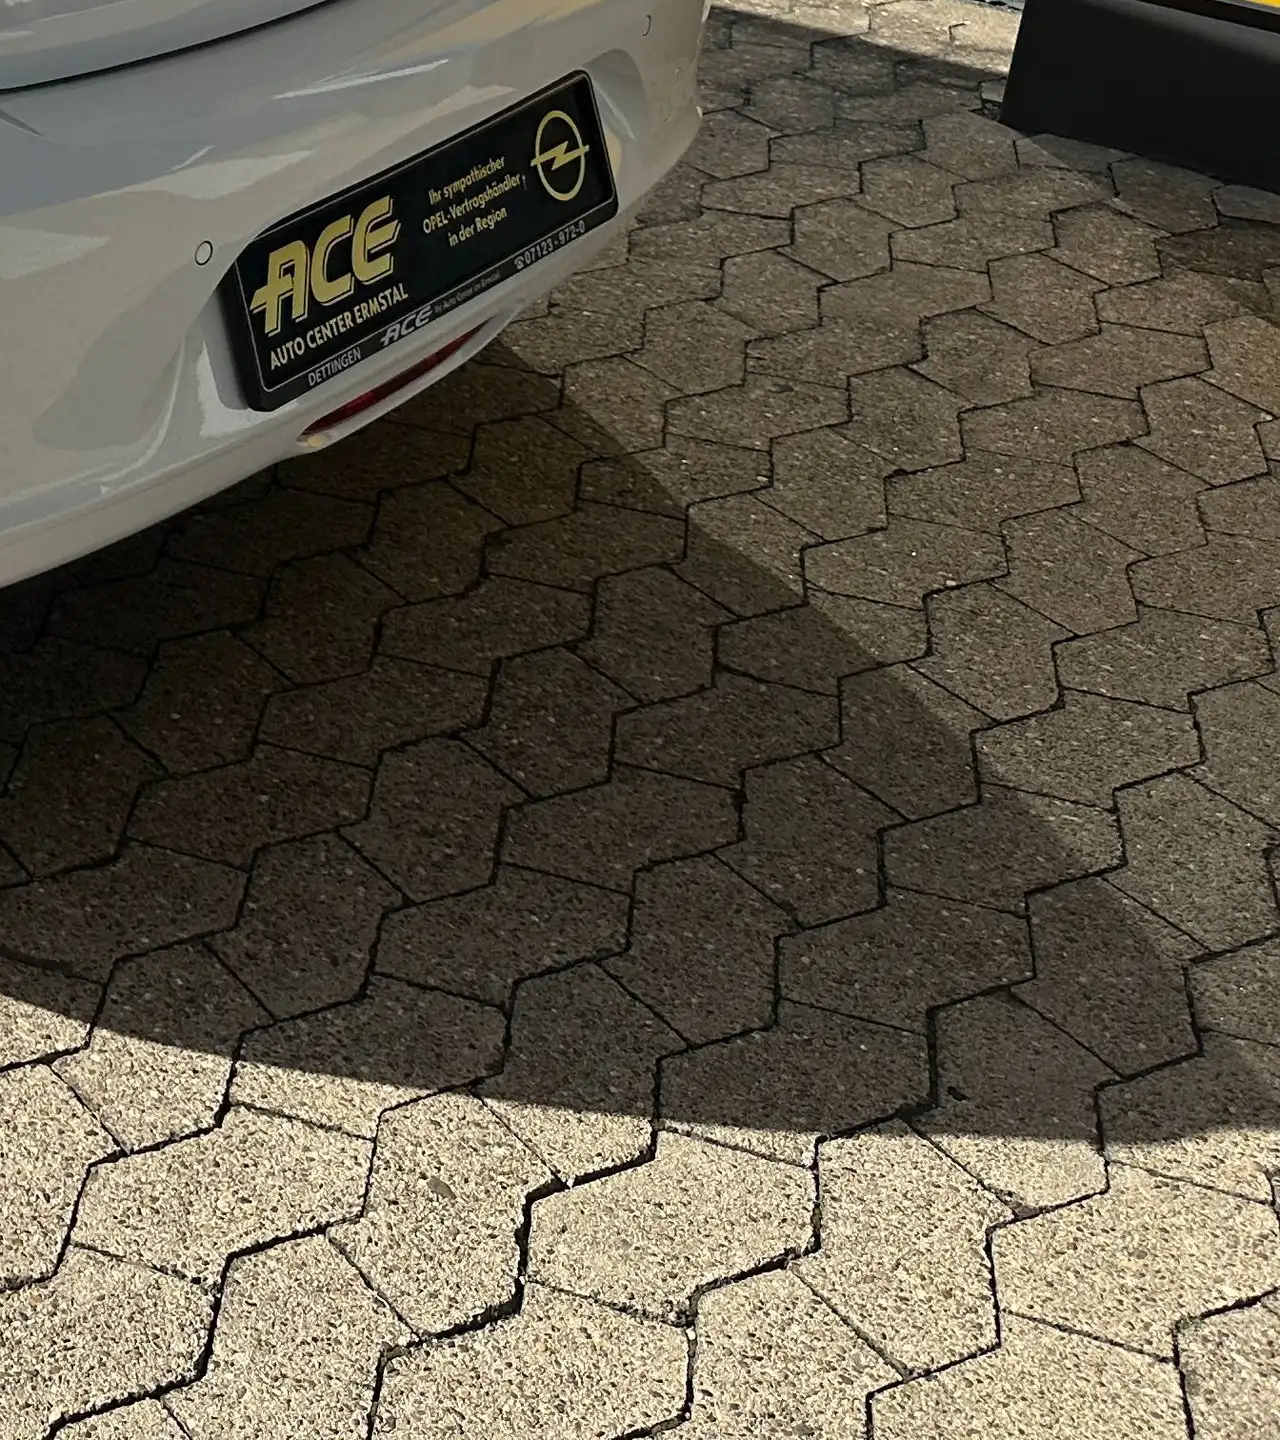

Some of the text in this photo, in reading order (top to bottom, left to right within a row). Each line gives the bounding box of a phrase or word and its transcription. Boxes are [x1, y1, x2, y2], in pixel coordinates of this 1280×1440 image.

[423, 173, 521, 234] OPEL-Vertragshändler
[428, 156, 505, 205] Ihr sympathischer
[447, 207, 507, 247] in der Region
[249, 194, 402, 338] ACE
[270, 283, 409, 371] AUTO CENTER ERMSTAL
[308, 346, 362, 387] DETTINGEN
[380, 304, 433, 347] ACE
